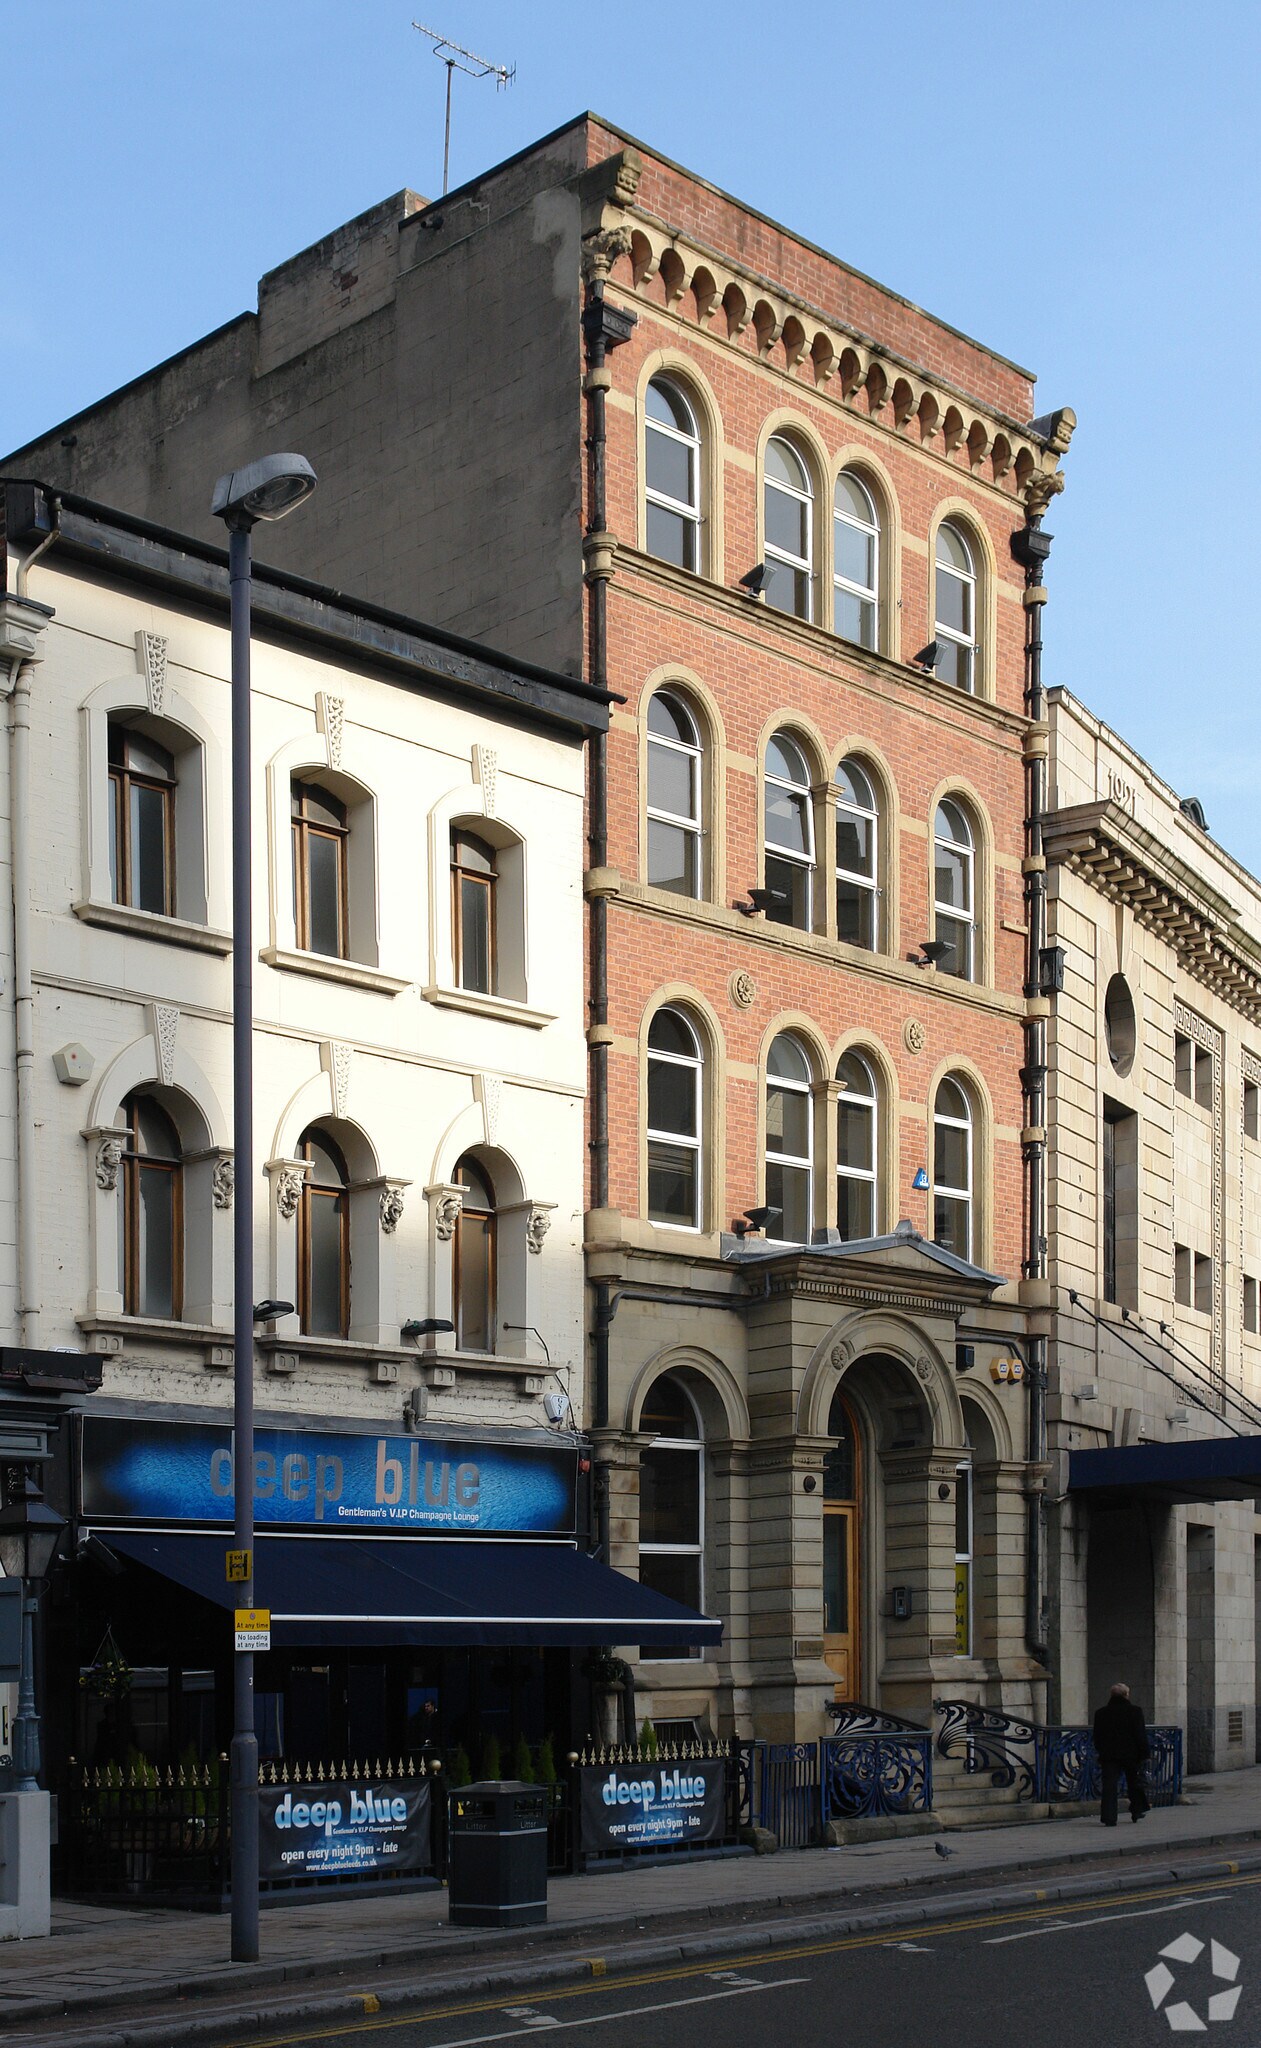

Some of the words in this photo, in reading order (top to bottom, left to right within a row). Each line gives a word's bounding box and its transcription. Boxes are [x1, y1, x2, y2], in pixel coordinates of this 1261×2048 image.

[210, 1430, 344, 1520] deep
[375, 1440, 480, 1507] blue
[338, 1506, 387, 1518] Gentleman's
[389, 1508, 408, 1518] V.I.P
[409, 1509, 452, 1521] Champagne
[453, 1511, 479, 1522] Lounge
[245, 1622, 255, 1630] any
[247, 1634, 268, 1642] loading
[602, 1773, 656, 1812] deep
[660, 1769, 706, 1801] blue
[274, 1793, 342, 1837] deep
[350, 1789, 408, 1825] blue
[609, 1825, 626, 1836] open
[628, 1823, 646, 1833] every
[647, 1819, 666, 1832] night
[666, 1818, 683, 1831] 9pm
[689, 1816, 701, 1826] late
[281, 1850, 304, 1865] open
[306, 1850, 329, 1862] every
[331, 1844, 354, 1860] night
[355, 1843, 374, 1858] 9pm
[383, 1842, 398, 1853] late
